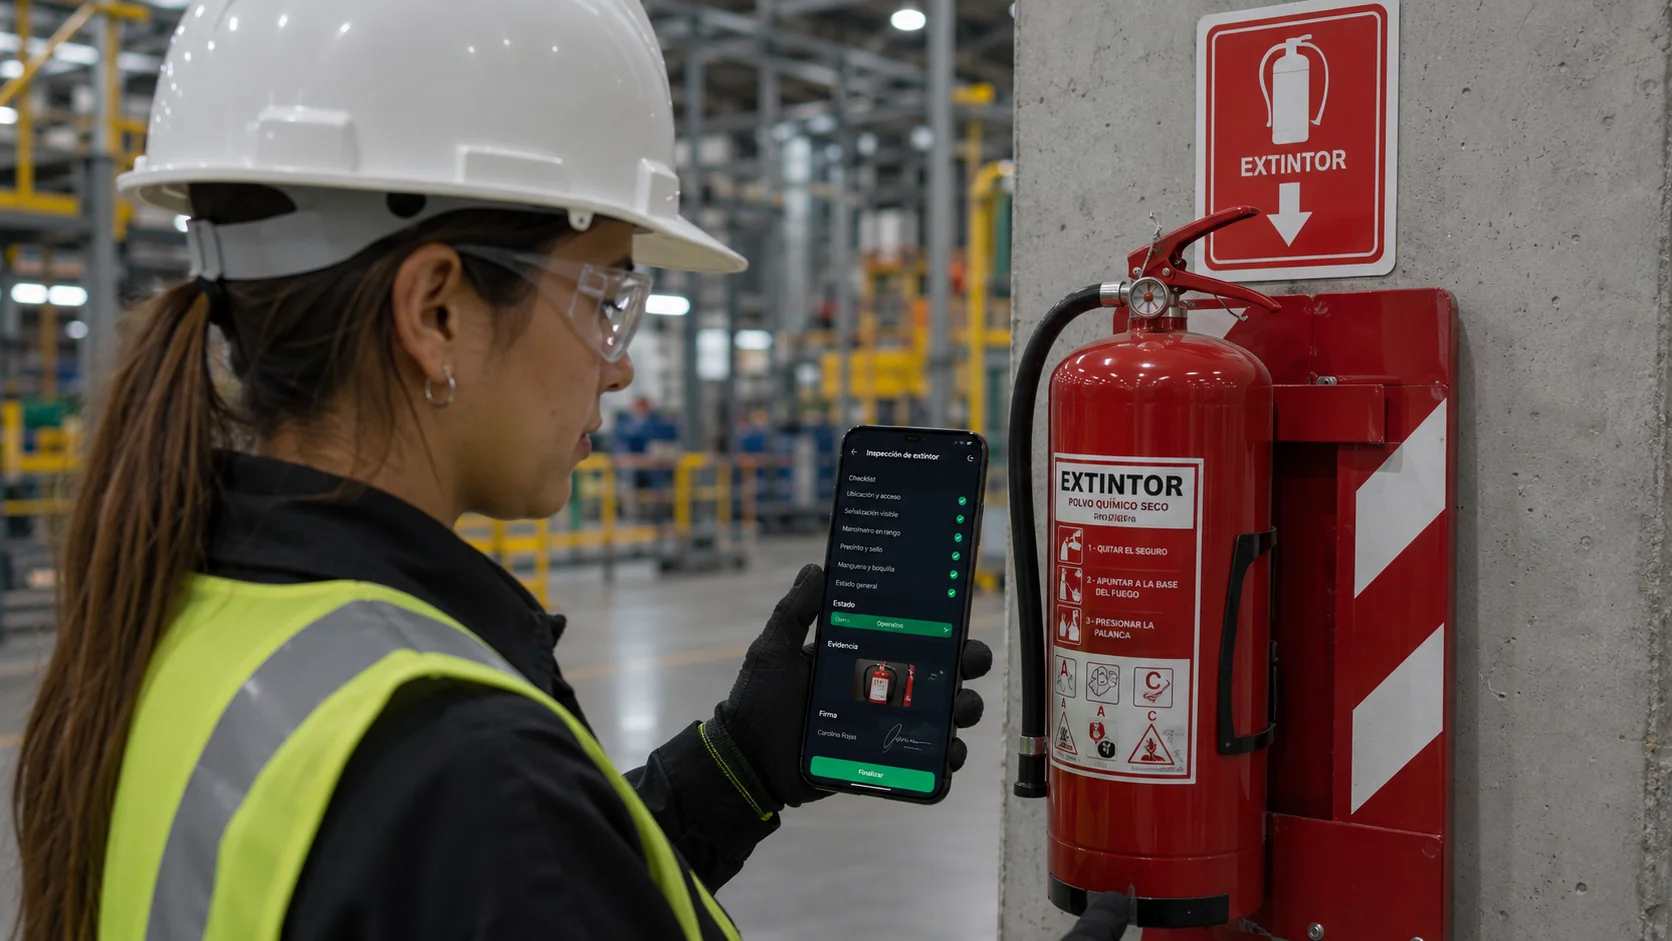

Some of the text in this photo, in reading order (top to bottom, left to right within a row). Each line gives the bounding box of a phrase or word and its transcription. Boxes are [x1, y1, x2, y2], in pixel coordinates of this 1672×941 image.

[1241, 149, 1347, 177] EXTINTOR
[866, 449, 940, 461] Inspección de extintor
[848, 474, 876, 483] Checklist
[1061, 470, 1183, 497] EXTINTOR
[846, 490, 875, 498] Ubicación
[880, 493, 901, 501] acceso
[1068, 497, 1094, 508] POLVO
[1140, 502, 1169, 512] SECO
[880, 510, 899, 518] visible
[840, 543, 864, 551] Precinto
[1097, 545, 1123, 555] QUITAR
[1125, 547, 1134, 555] EL
[1135, 547, 1168, 556] SEGURO
[838, 562, 867, 571] Manguera
[872, 565, 895, 573] boquilla
[835, 579, 877, 590] Estado general
[1096, 577, 1134, 587] APUNTAR
[1135, 580, 1142, 588] A
[1143, 580, 1155, 588] LA
[1156, 581, 1179, 589] BASE
[1095, 588, 1140, 599] DEL FUEGO
[833, 600, 855, 609] Estado
[1095, 618, 1142, 629] PRESIONAR
[1143, 621, 1154, 630] LA
[1094, 629, 1131, 639] PALANCA
[827, 640, 858, 650] Evidencia
[1145, 671, 1161, 690] C
[1061, 697, 1067, 709] A
[818, 710, 838, 719] Firma
[1096, 705, 1106, 717] A
[1147, 710, 1157, 722] C
[817, 729, 857, 741] Carolina Rojas
[858, 768, 884, 779] Finalizar
